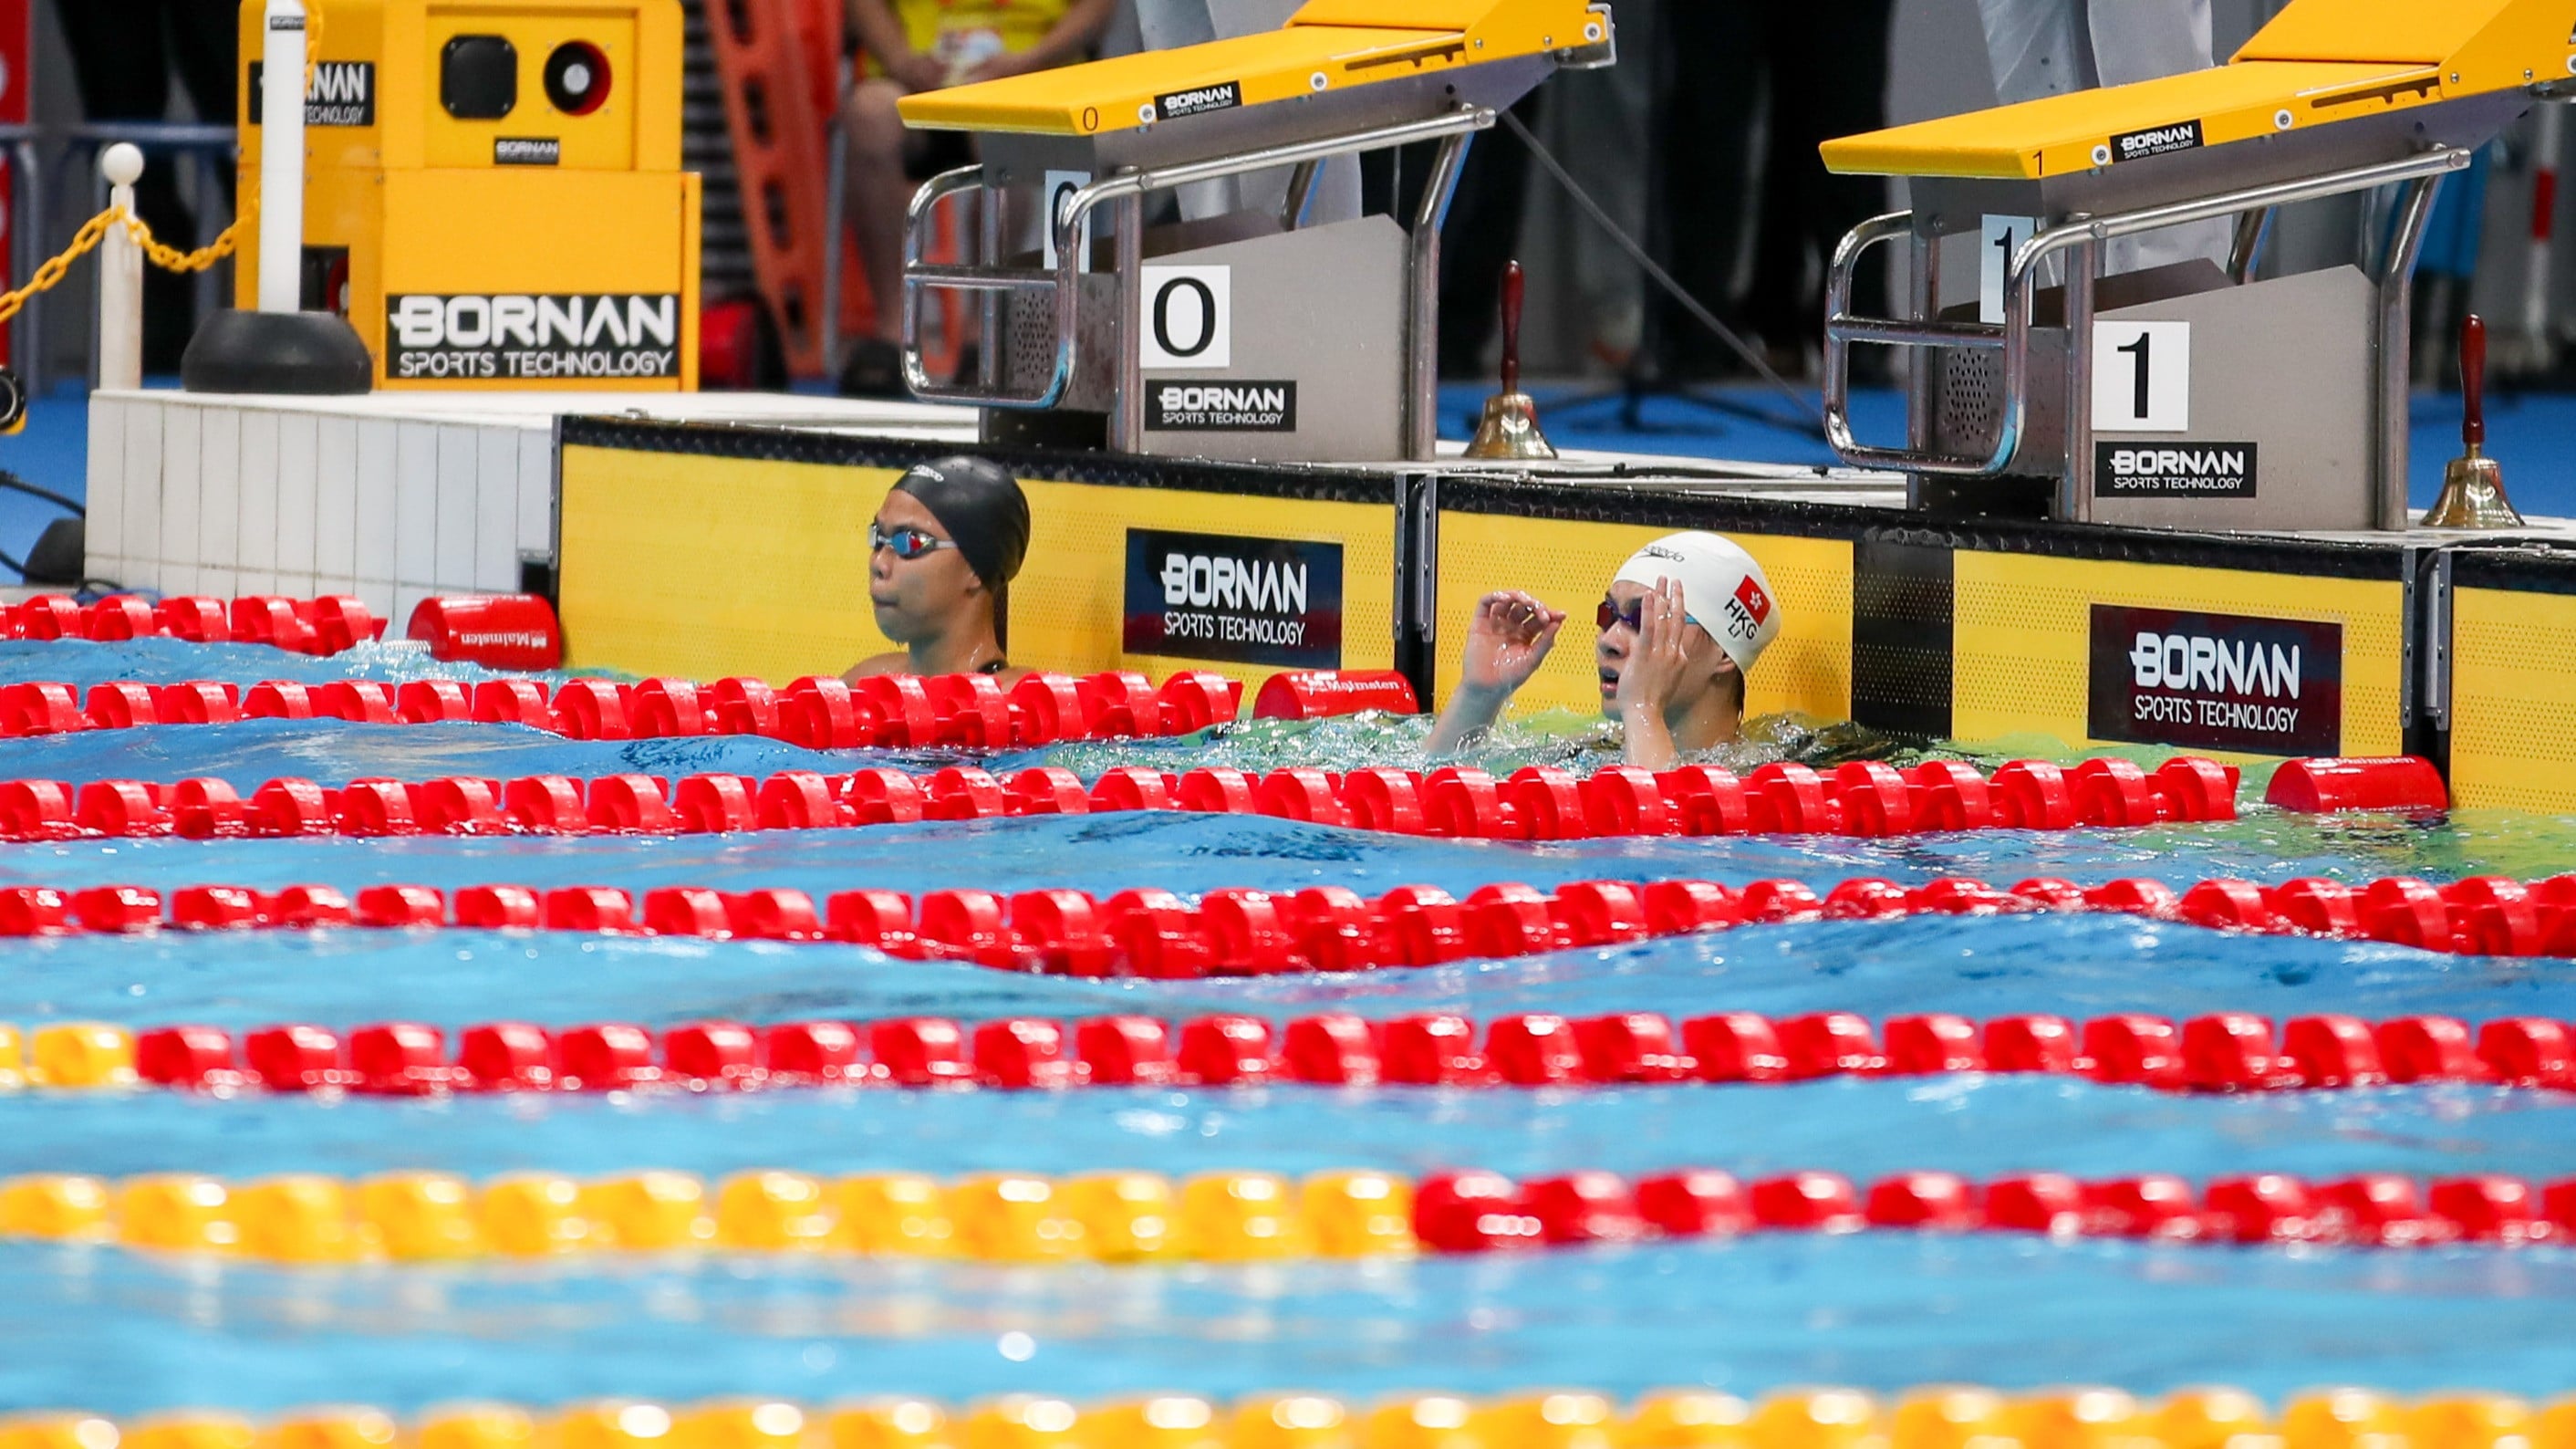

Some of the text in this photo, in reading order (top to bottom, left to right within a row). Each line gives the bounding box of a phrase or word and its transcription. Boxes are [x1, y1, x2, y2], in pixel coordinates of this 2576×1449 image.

[1164, 86, 1232, 109] BORNAN
[1083, 107, 1098, 131] 0
[496, 141, 558, 153] BORNAN
[2121, 125, 2193, 151] BORNAN
[2152, 140, 2194, 153] TECHNOLOGY
[2033, 150, 2042, 176] 1
[1994, 226, 2012, 312] 1
[390, 295, 674, 347] BORNAN
[1153, 276, 1216, 357] 0
[400, 351, 673, 377] SPORTS TECHNOLOGY
[2117, 332, 2150, 419] 1
[1159, 387, 1284, 411] BORNAN
[1162, 412, 1284, 424] SPORTS TECHNOLOGY
[2109, 451, 2244, 474] BORNAN
[2114, 476, 2244, 490] SPORTS TECHNOLOGY
[1160, 553, 1307, 615] BORNAN
[1164, 611, 1306, 646] SPORTS TECHNOLOGY
[1724, 598, 1758, 640] HKG
[1728, 623, 1741, 639] LI
[461, 632, 530, 647] Malmsten
[2129, 631, 2301, 699] BORNAN
[1327, 681, 1399, 693] Malmsten
[2135, 694, 2299, 733] SPORTS TECHNOLOGY
